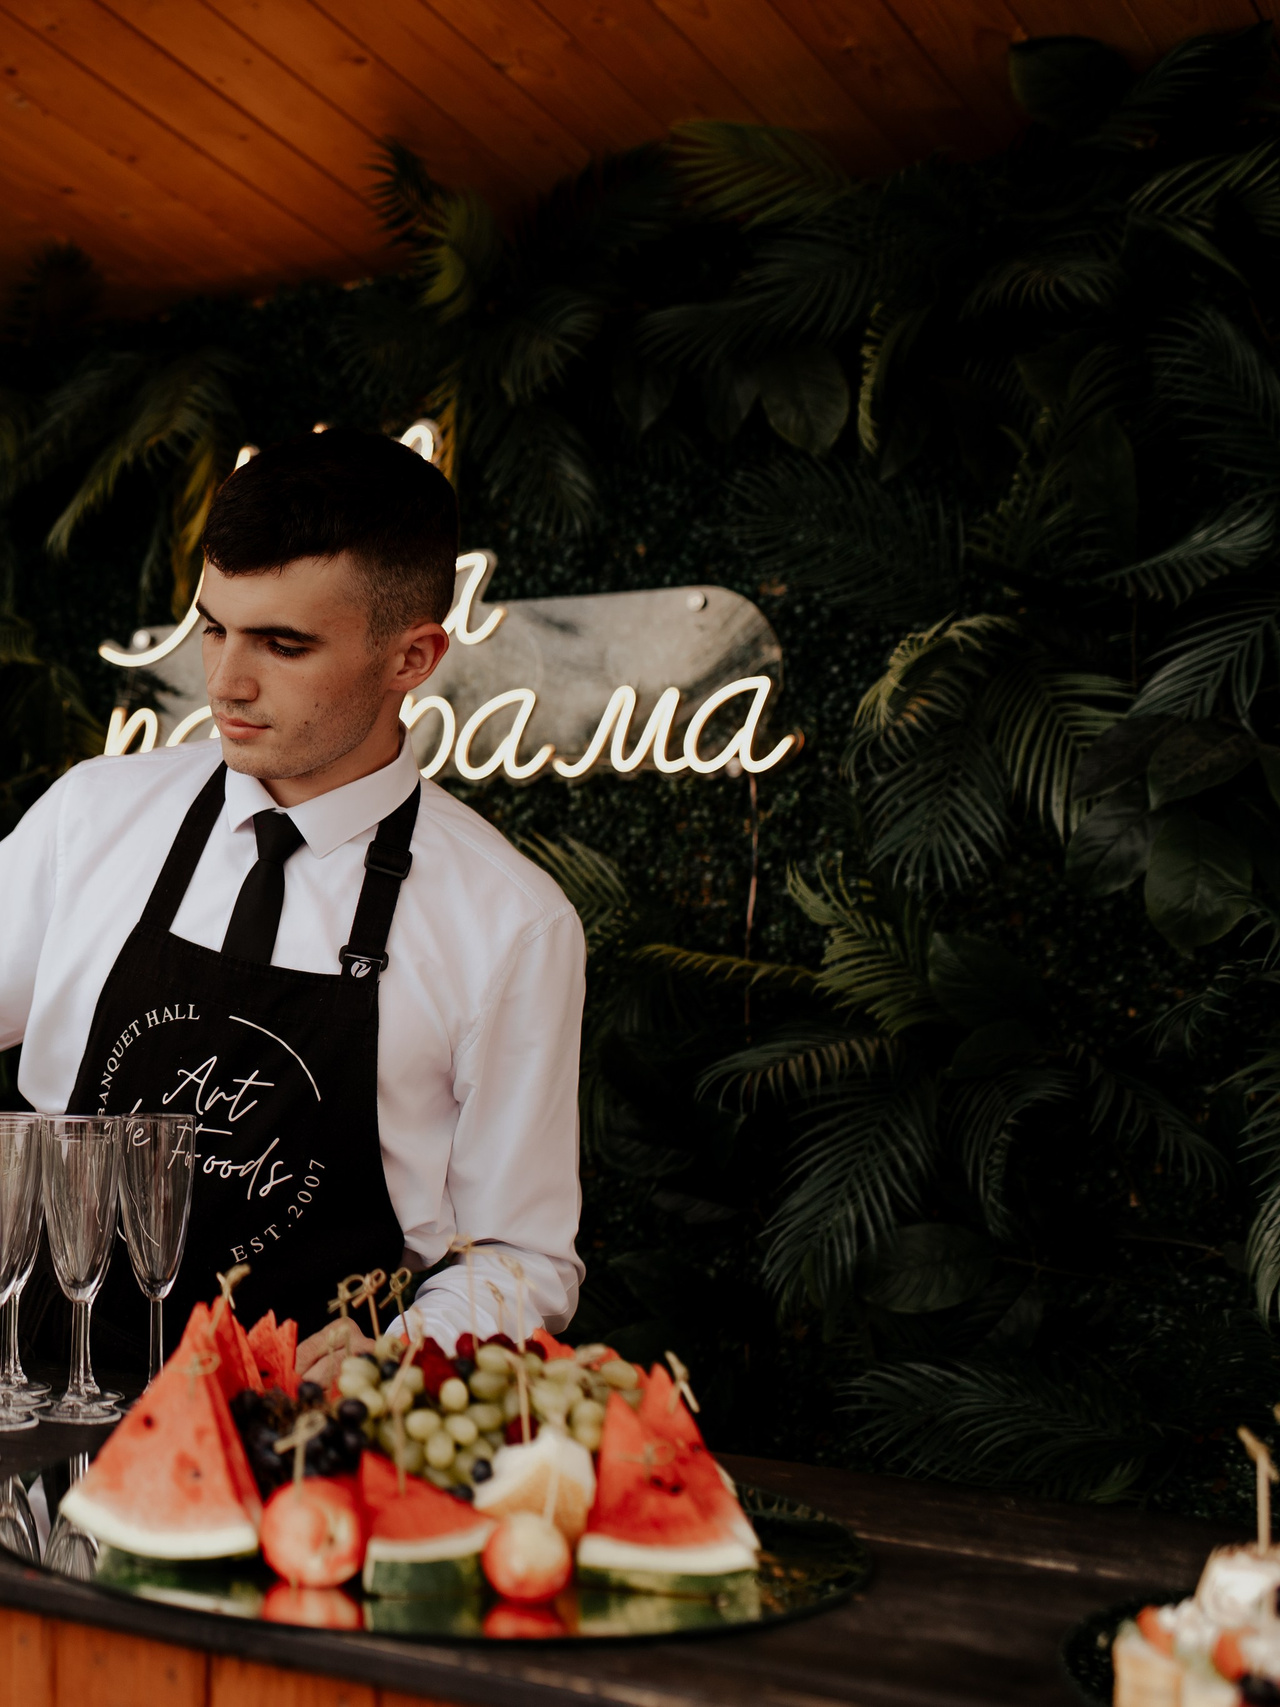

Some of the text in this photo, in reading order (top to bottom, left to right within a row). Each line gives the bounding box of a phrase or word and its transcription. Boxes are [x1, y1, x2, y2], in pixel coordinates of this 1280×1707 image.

[145, 1003, 200, 1029] HALL
[162, 1055, 274, 1122] Art
[167, 1122, 293, 1201] Foods
